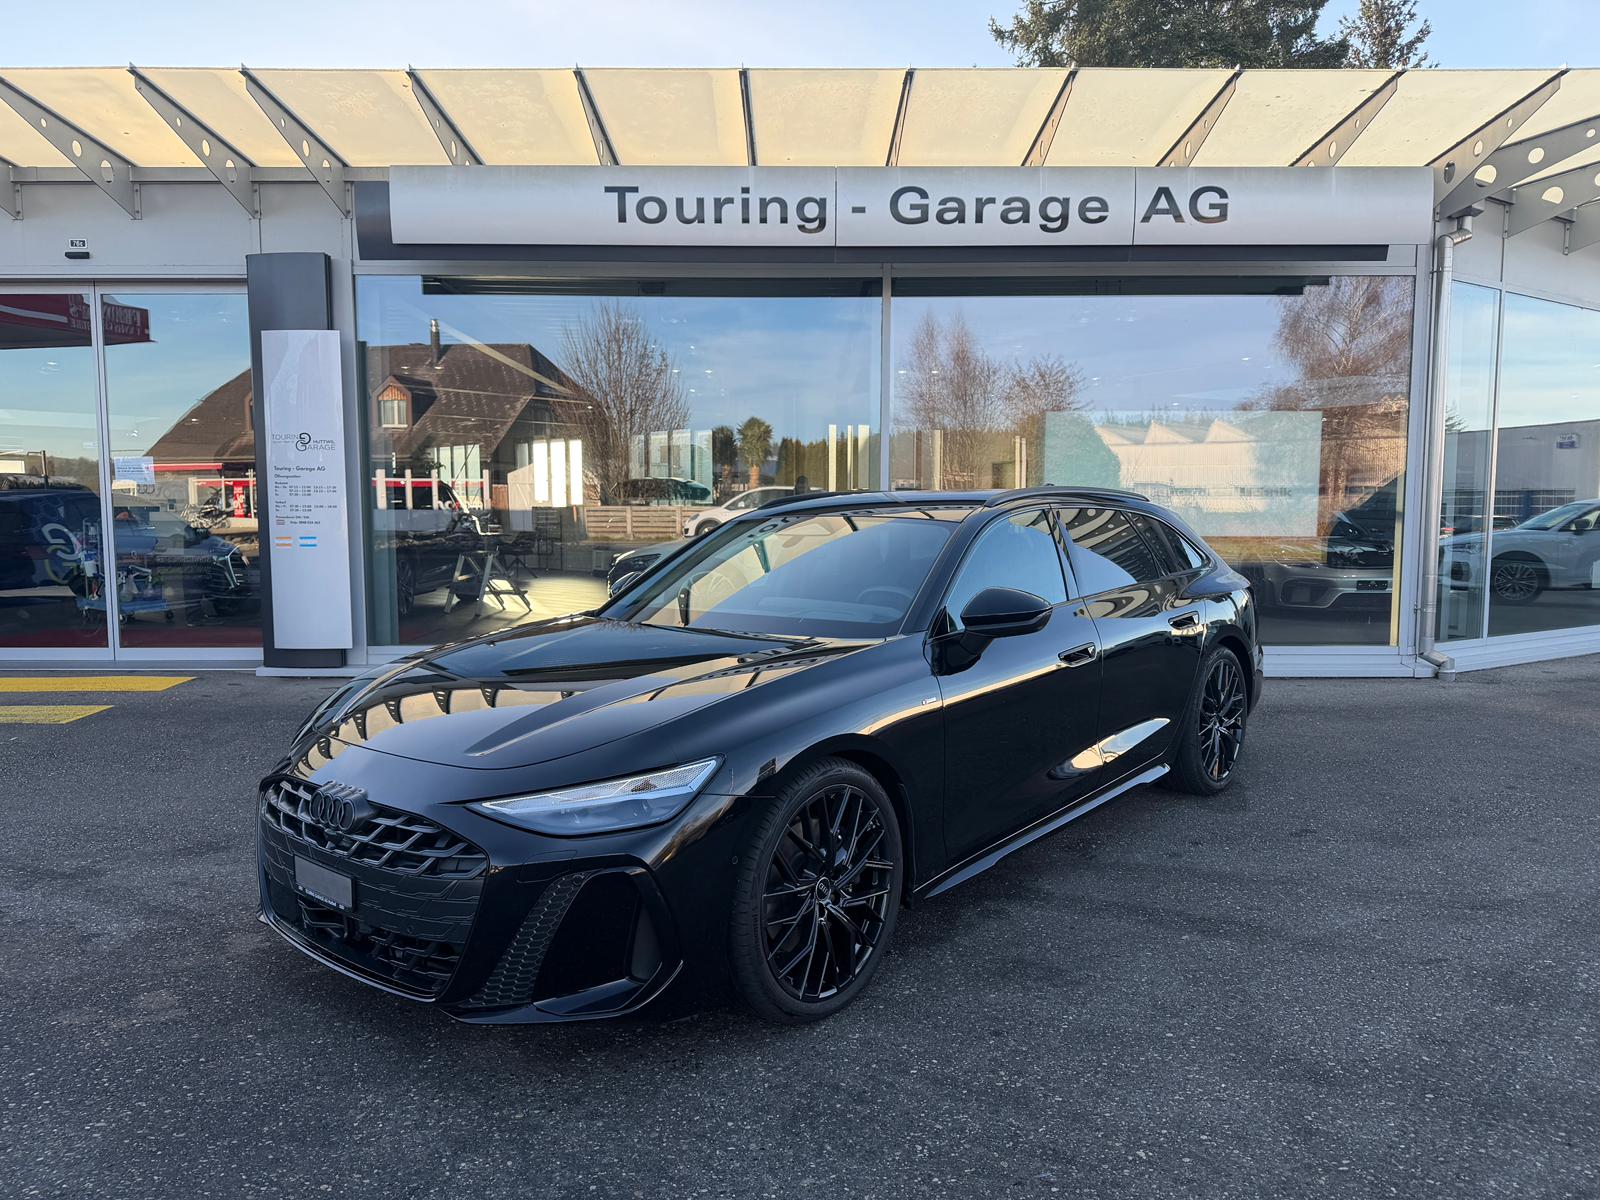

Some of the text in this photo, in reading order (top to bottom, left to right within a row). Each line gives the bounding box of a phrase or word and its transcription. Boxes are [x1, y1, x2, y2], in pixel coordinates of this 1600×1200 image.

[604, 185, 1230, 234] Touring - Garage AG
